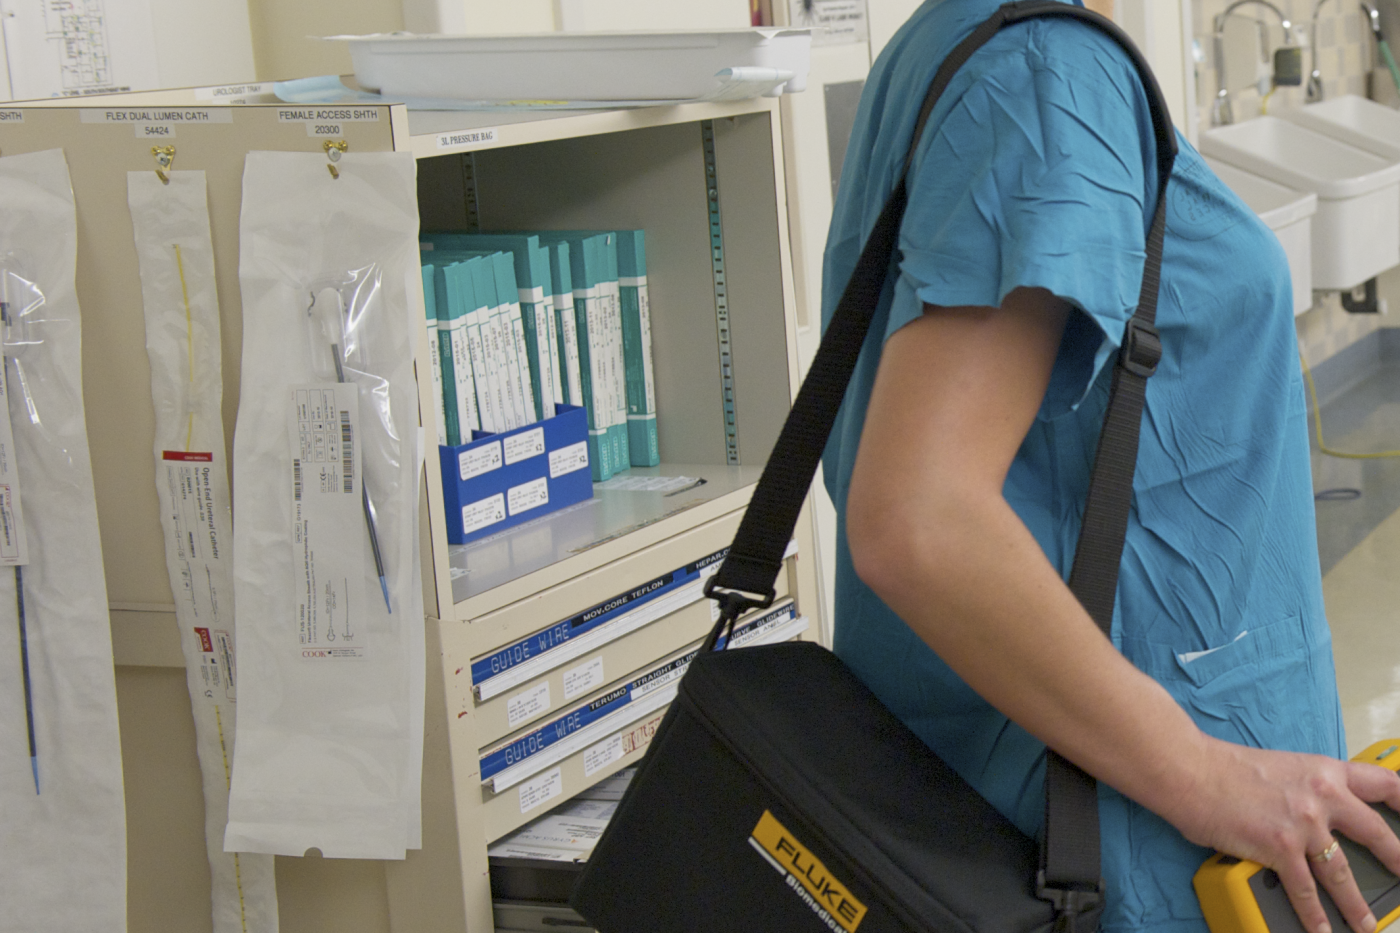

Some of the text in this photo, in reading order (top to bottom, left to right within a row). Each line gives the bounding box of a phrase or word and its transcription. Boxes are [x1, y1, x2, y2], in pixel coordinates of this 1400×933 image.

[212, 84, 262, 97] UROLOGIST TRAY
[0, 112, 22, 120] SHTH
[106, 112, 209, 120] FLEX DUAL LUMEN CATH
[279, 110, 378, 120] FEMALE ACCESS SHTH
[145, 127, 169, 135] 54424
[315, 125, 340, 134] 20300
[450, 133, 480, 145] PRESSURE
[481, 131, 493, 141] BAG
[205, 502, 216, 530] Ureteral
[208, 531, 220, 560] Catheter
[583, 579, 664, 622] MOV.CORE TEFLON
[756, 604, 794, 627] GLIDEWIRE
[734, 628, 760, 646] SENSOR
[490, 623, 570, 674] GUIDE WIRE
[632, 664, 672, 689] STRAIGHT
[641, 674, 671, 693] SENSOR
[590, 687, 627, 710] TERUMO
[505, 712, 582, 765] GUIDE WIRE
[775, 836, 859, 924] FLUKE
